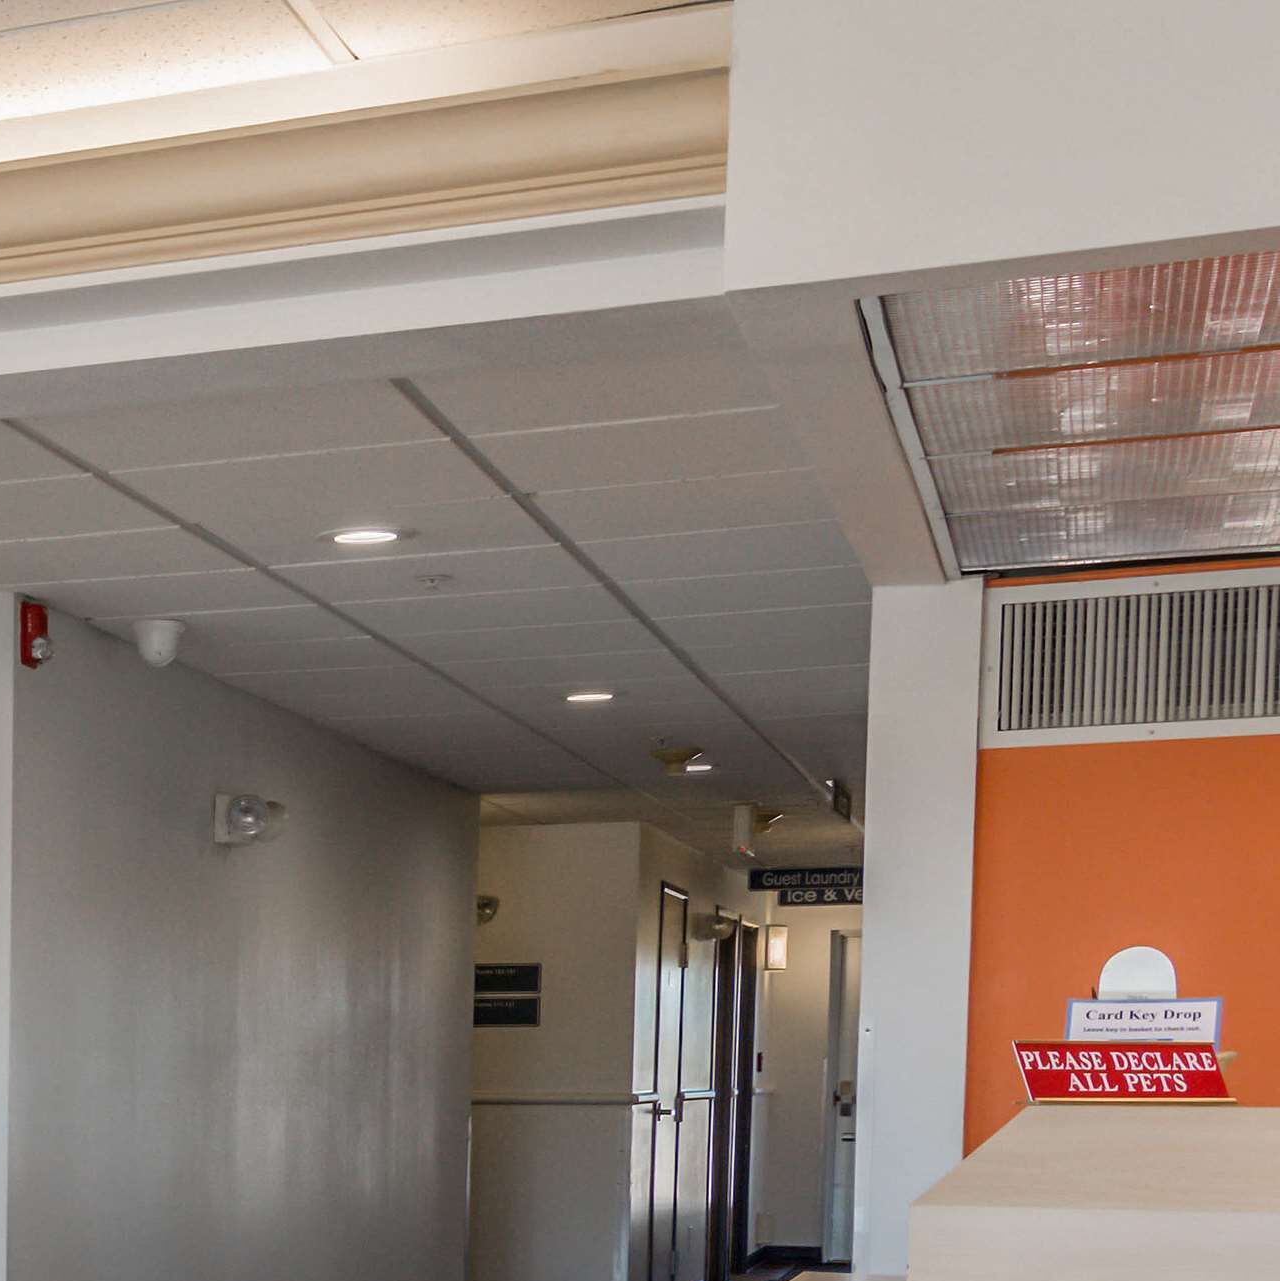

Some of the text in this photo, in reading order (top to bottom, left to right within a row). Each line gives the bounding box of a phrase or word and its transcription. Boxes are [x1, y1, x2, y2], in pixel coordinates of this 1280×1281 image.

[762, 870, 860, 886] Guest Laundry
[788, 888, 817, 902] Ice
[823, 888, 838, 902] &
[1085, 1009, 1202, 1023] Card Key Drop
[1020, 1051, 1217, 1072] PLEASE DECLARE
[1068, 1073, 1188, 1093] ALL PETS
